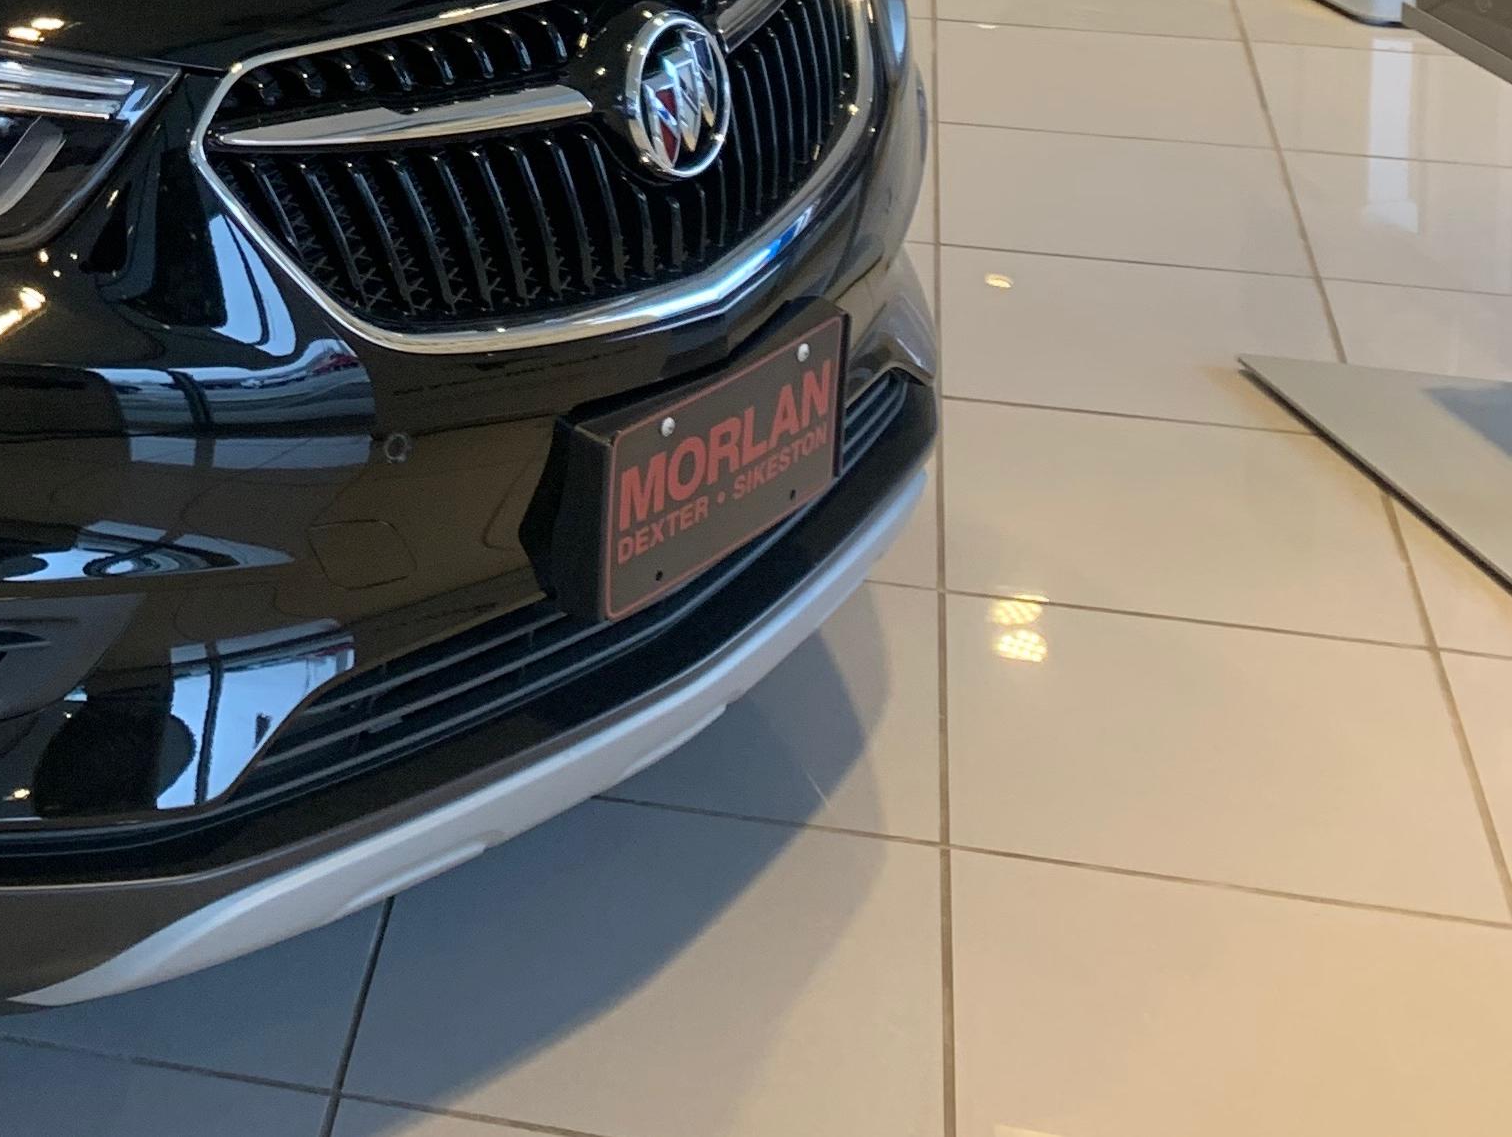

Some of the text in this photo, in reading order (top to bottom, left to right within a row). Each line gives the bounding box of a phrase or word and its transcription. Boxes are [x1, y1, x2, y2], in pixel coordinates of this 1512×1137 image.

[616, 423, 829, 565] DEXTER SIKESTON
[618, 359, 833, 532] MORLAN
